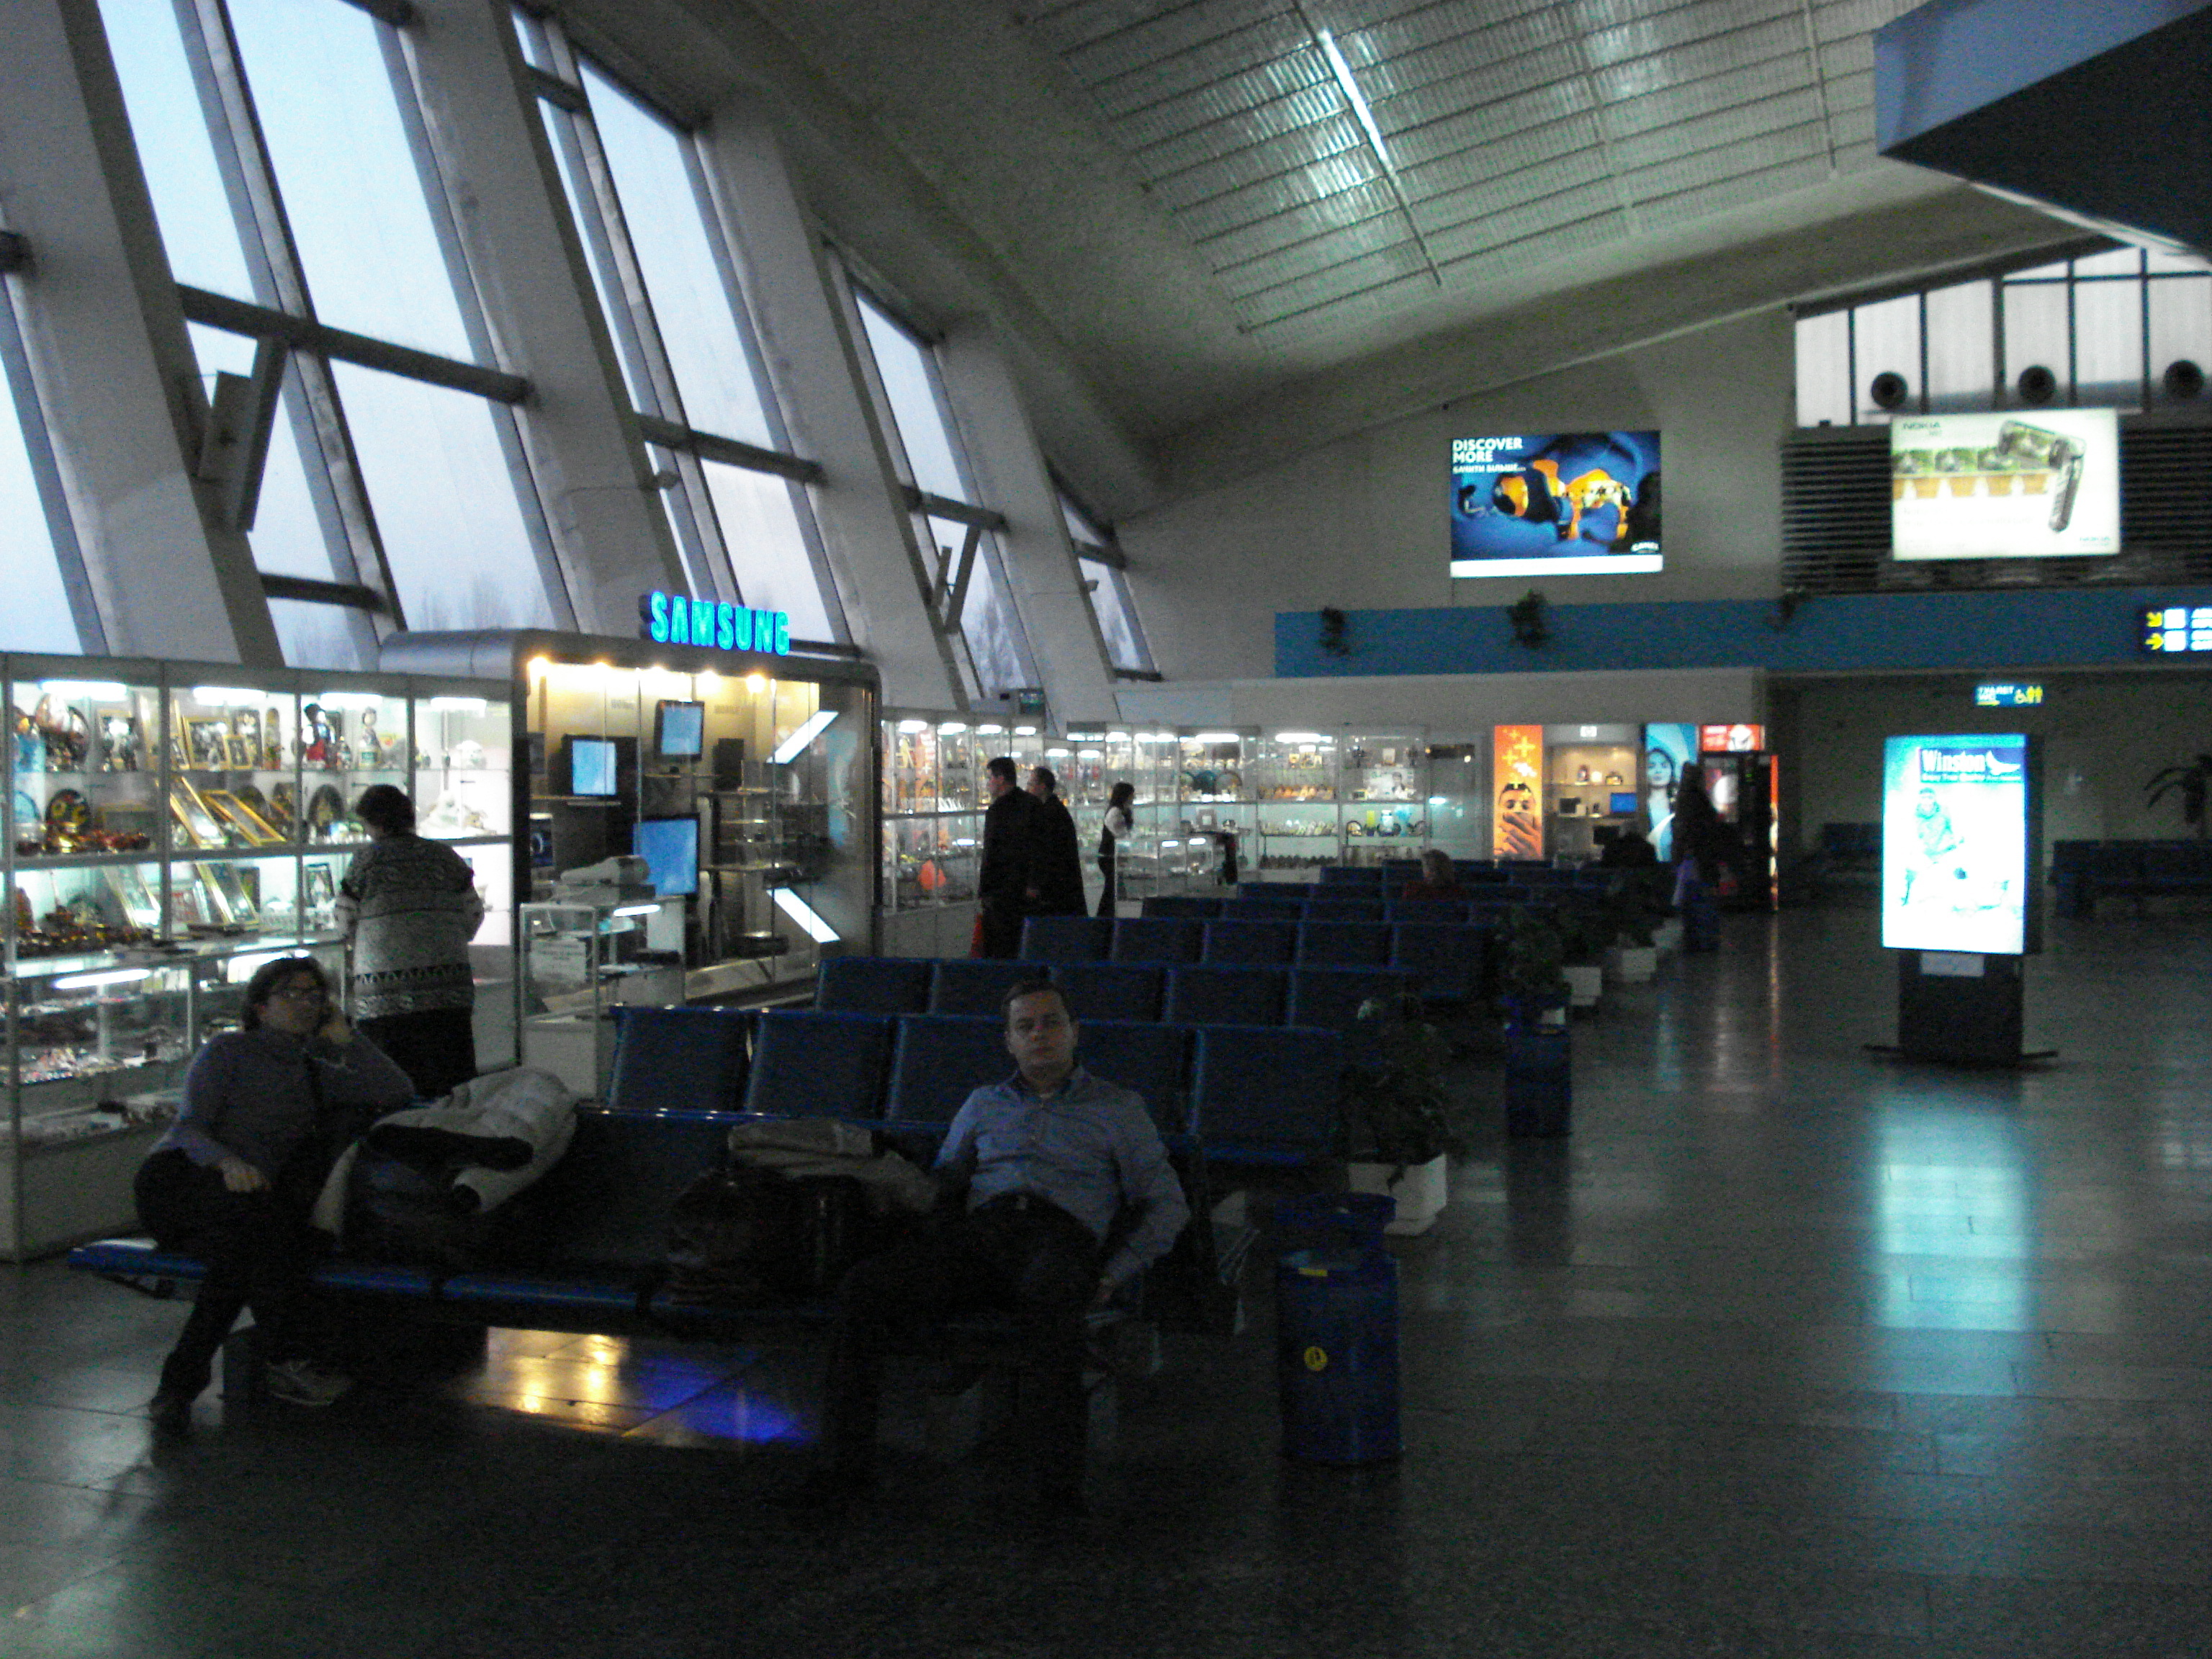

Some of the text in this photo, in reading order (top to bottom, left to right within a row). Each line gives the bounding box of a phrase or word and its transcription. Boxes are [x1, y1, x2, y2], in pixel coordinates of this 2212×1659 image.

[1452, 437, 1523, 451] DISCOVER
[1452, 451, 1493, 463] MORE
[650, 590, 790, 656] SAMSUNG
[1922, 750, 1985, 772] Winston
